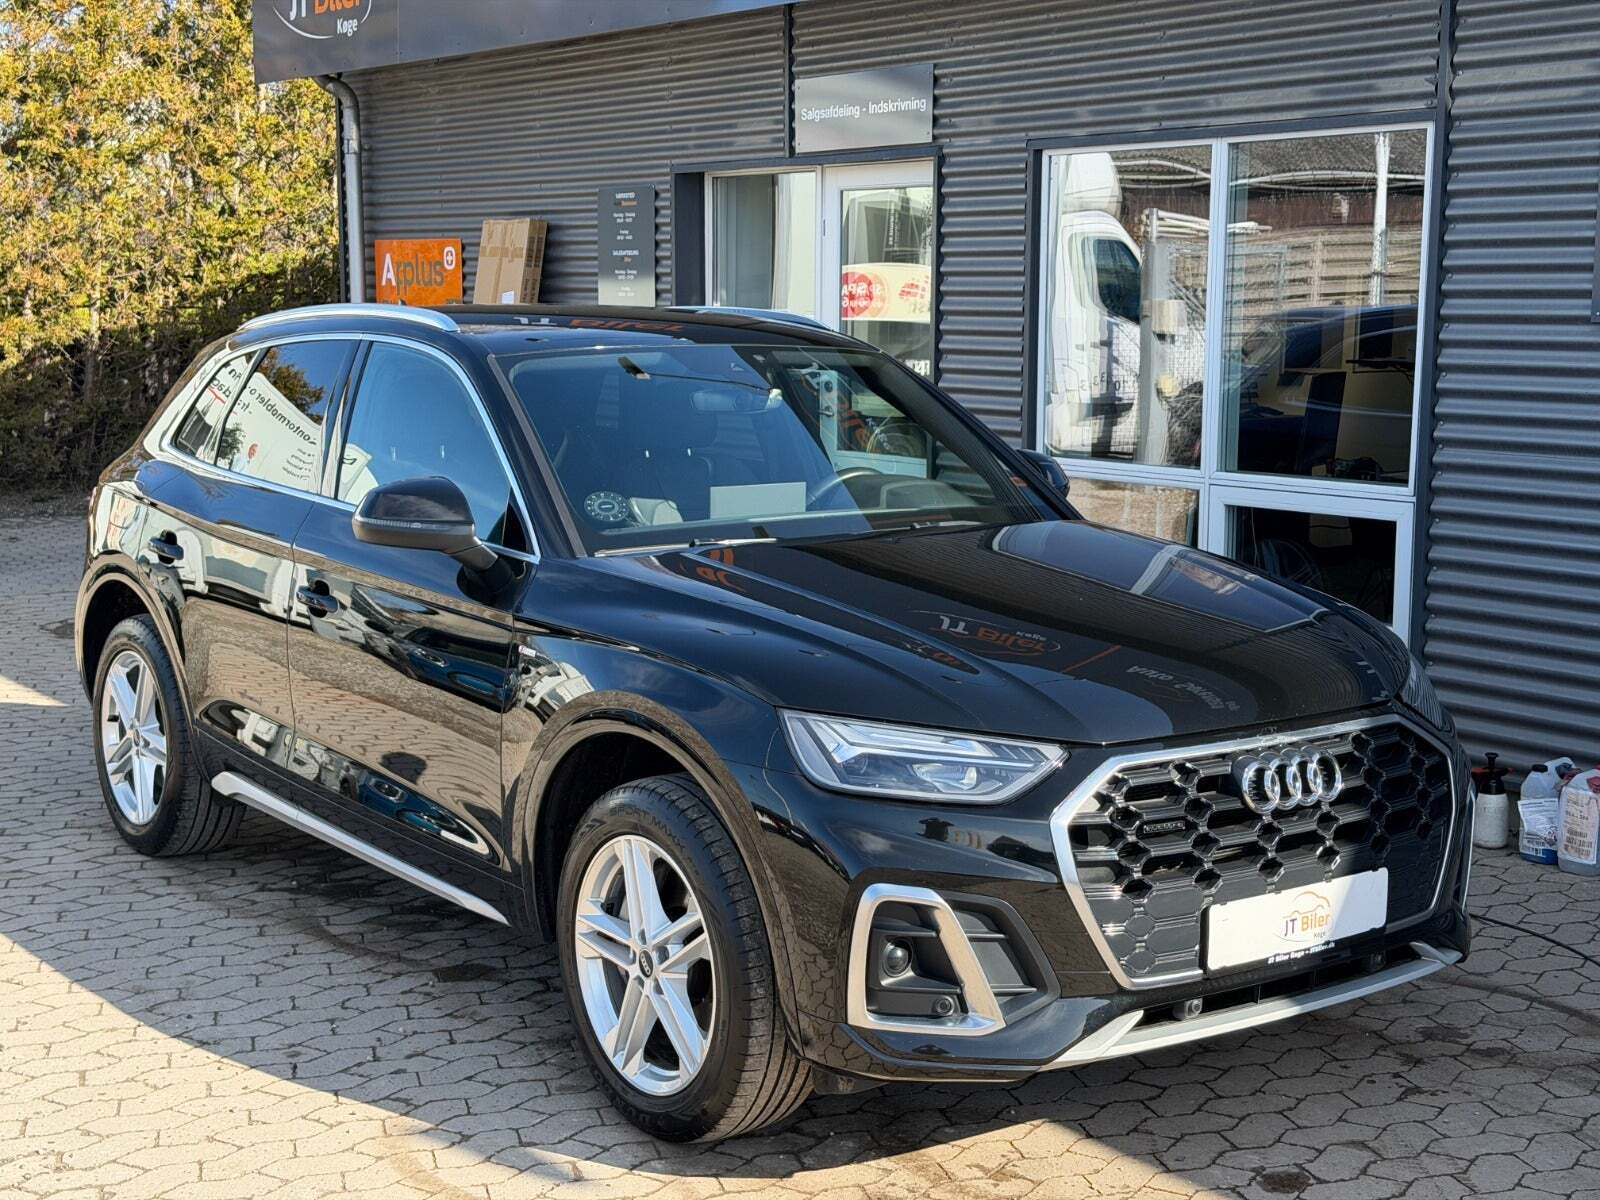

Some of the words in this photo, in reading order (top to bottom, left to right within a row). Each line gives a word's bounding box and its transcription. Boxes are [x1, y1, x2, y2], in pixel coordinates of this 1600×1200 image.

[336, 17, 358, 37] Køge
[800, 104, 861, 122] Salgsafdeling
[868, 96, 927, 114] Indskrivning
[1284, 918, 1298, 937] JT
[1301, 912, 1330, 931] Biler
